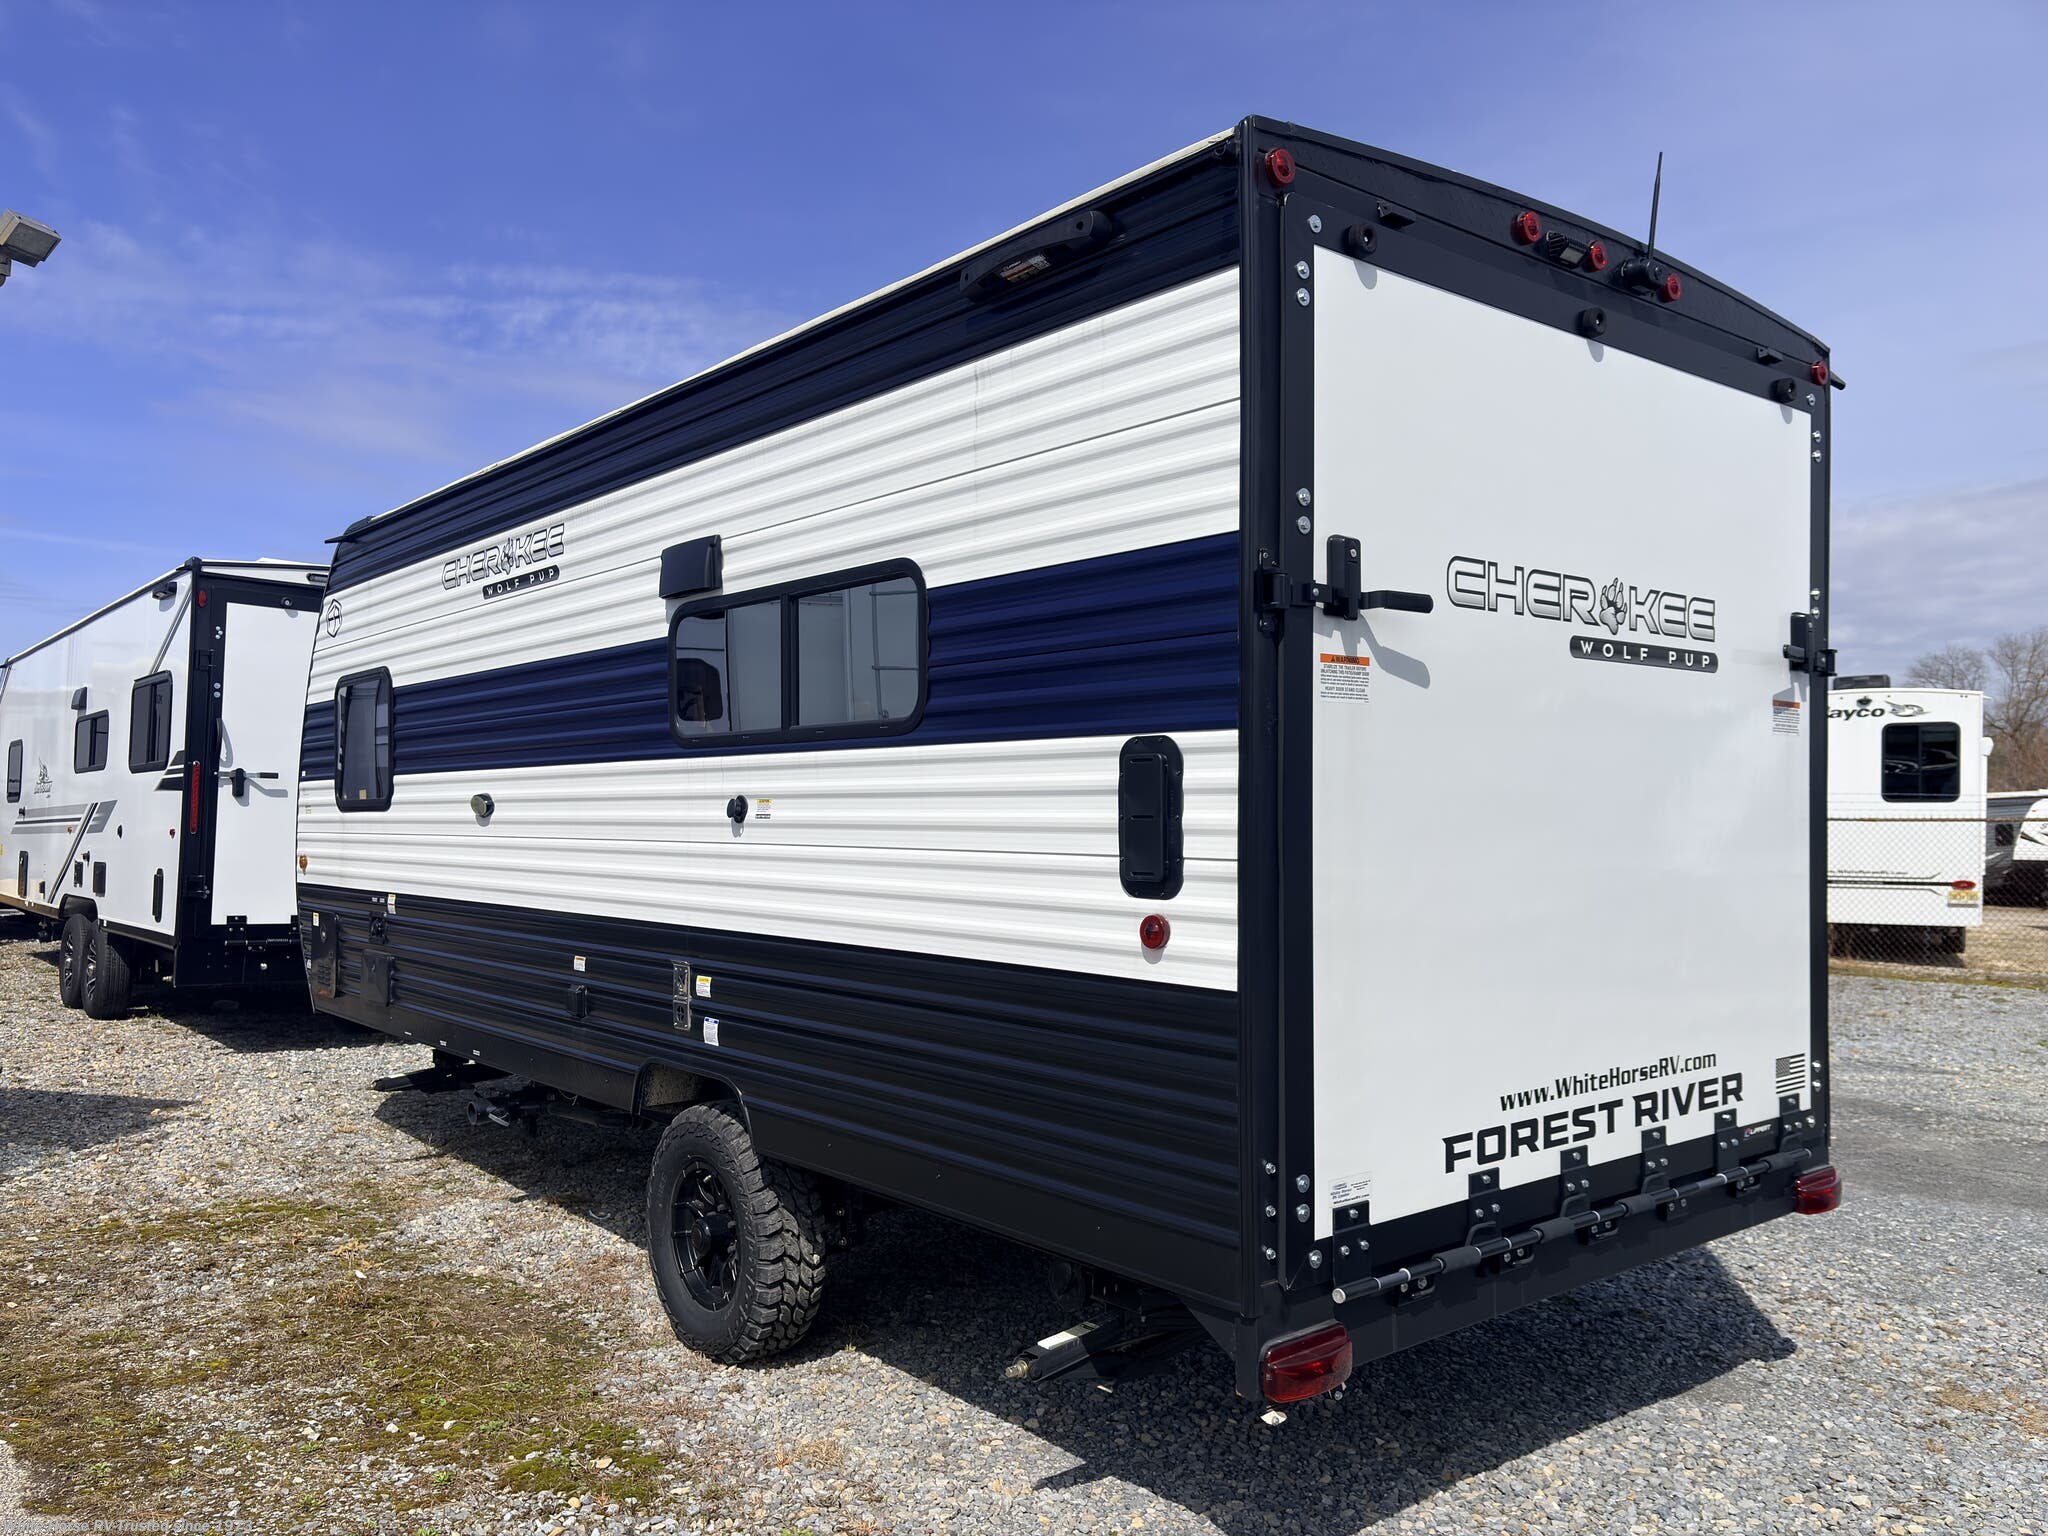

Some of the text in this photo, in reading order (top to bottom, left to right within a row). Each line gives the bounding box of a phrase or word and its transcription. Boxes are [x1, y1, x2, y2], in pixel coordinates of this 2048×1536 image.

[486, 568, 554, 596] WOLF PUP
[1579, 639, 1711, 668] WOLF PUP
[1828, 707, 1885, 721] ayco
[1500, 1052, 1717, 1112] www.WhiteHorseRV.com
[1442, 1072, 1744, 1174] FOREST RIVER
